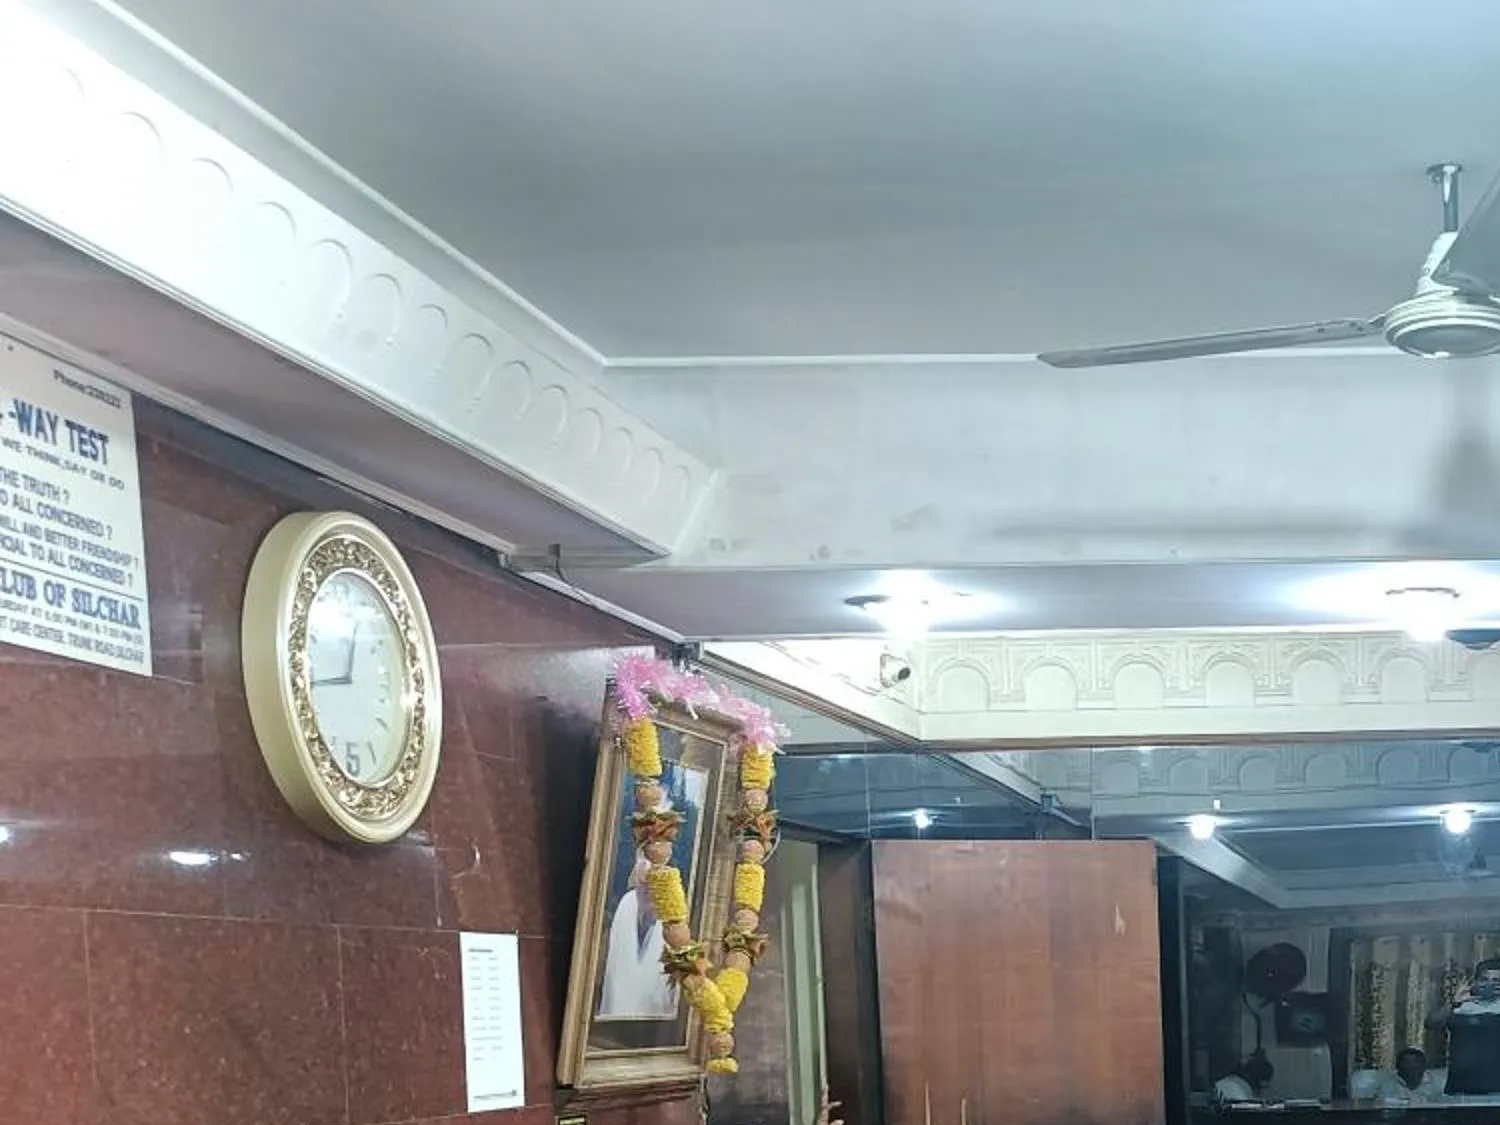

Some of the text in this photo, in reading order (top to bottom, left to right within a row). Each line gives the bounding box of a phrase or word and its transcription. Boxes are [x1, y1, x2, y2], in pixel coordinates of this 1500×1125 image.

[64, 418, 109, 465] TEST
[22, 473, 61, 502] TRUTH
[108, 476, 125, 491] DO
[13, 493, 34, 514] ALL
[37, 501, 105, 537] CONCERNED
[48, 548, 67, 569] ALL
[43, 580, 66, 609] OF
[71, 587, 141, 630] SILCHAR
